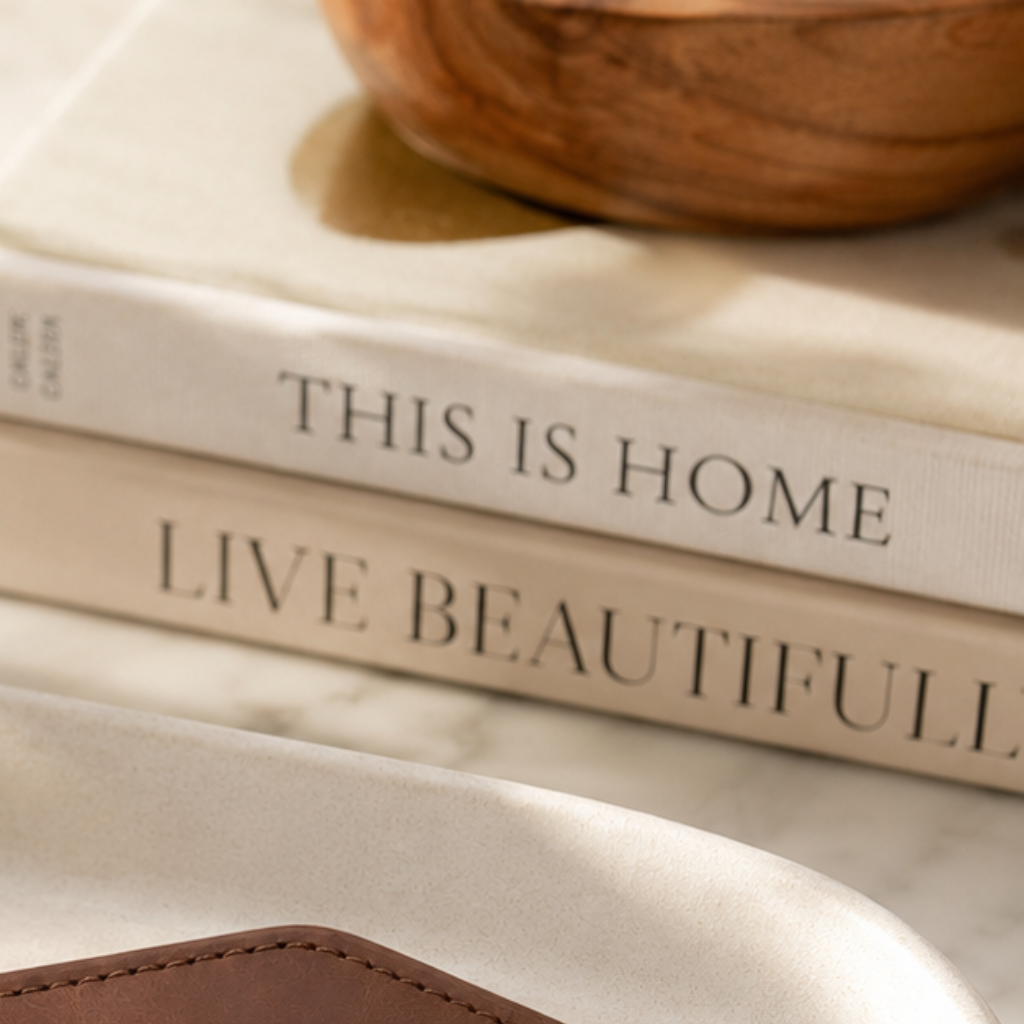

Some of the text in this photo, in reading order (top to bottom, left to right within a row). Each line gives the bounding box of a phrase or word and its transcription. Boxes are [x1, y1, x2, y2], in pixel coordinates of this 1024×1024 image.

[279, 372, 893, 547] THIS IS HOME
[158, 520, 1024, 759] LIVE BEAUTIFULL
